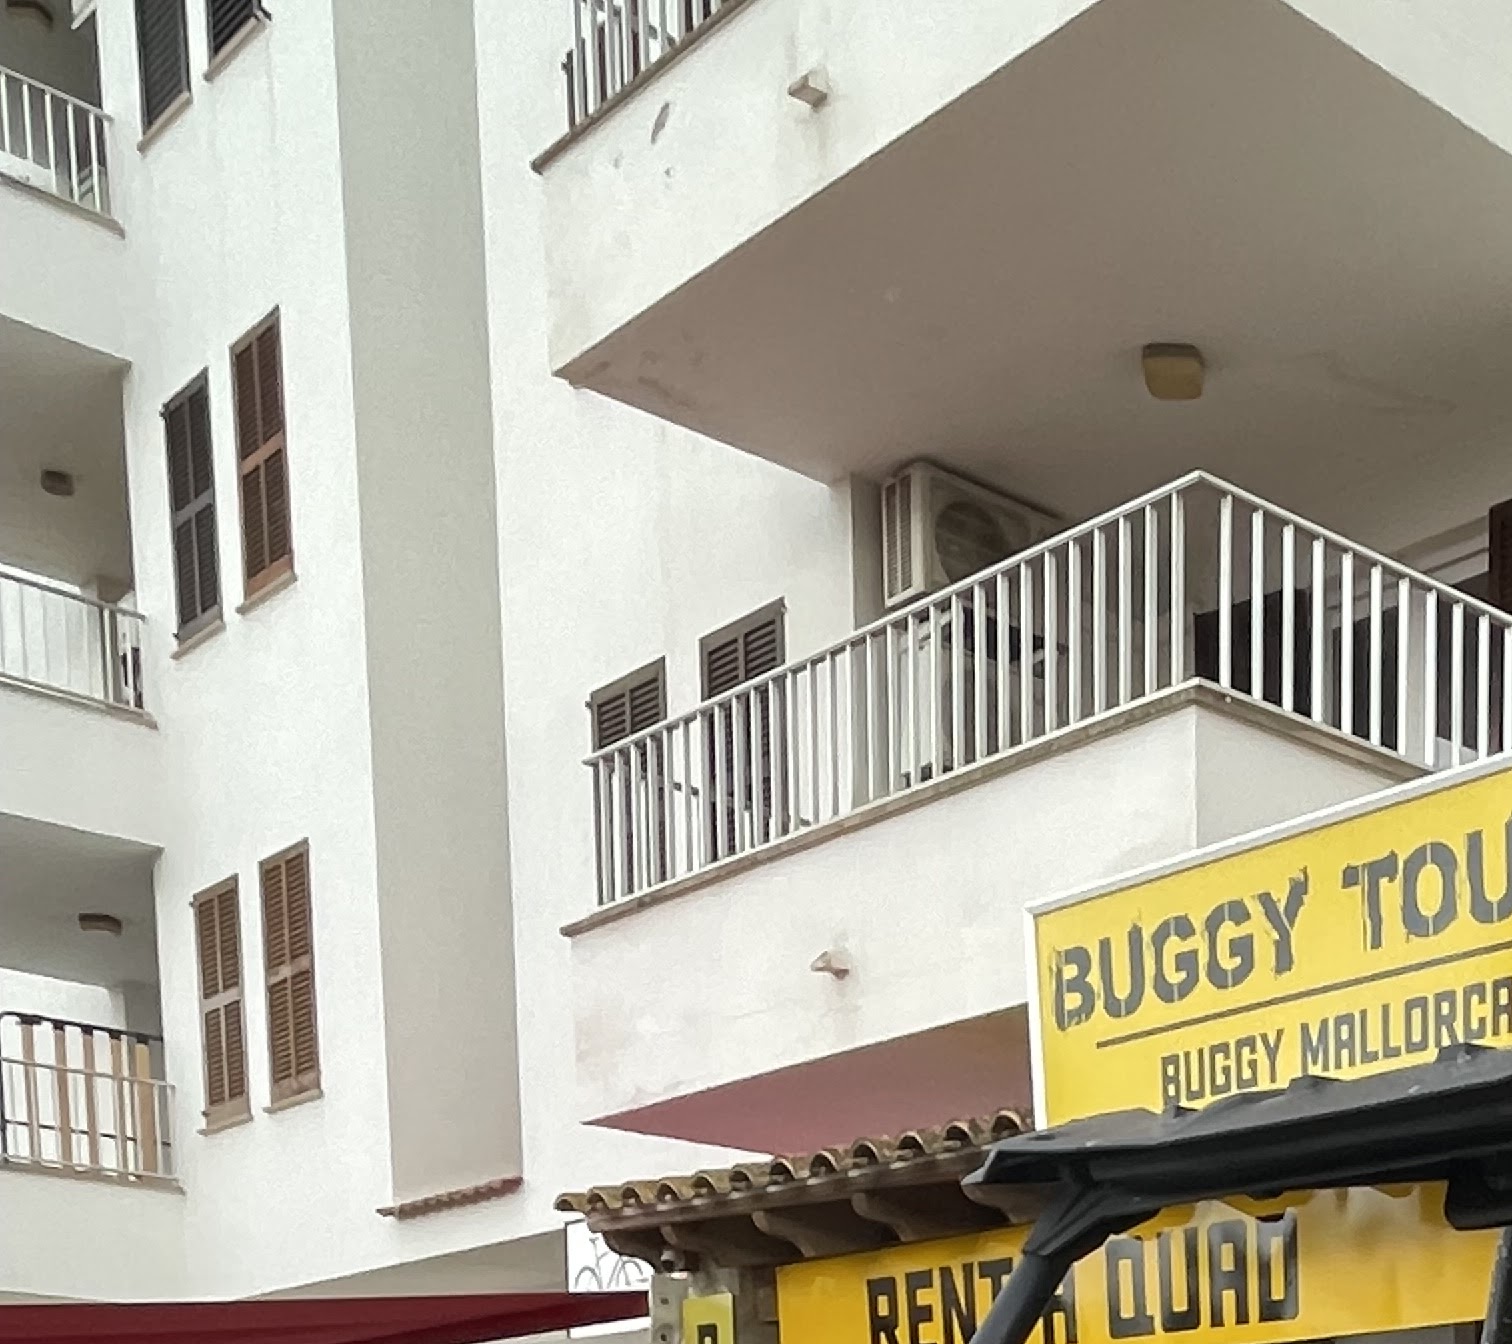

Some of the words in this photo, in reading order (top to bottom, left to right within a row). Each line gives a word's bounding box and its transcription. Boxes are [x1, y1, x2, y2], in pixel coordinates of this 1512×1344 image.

[1052, 867, 1309, 1033] BUGGY
[1160, 1029, 1285, 1104] BUGGY
[1105, 1215, 1300, 1340] QUAD
